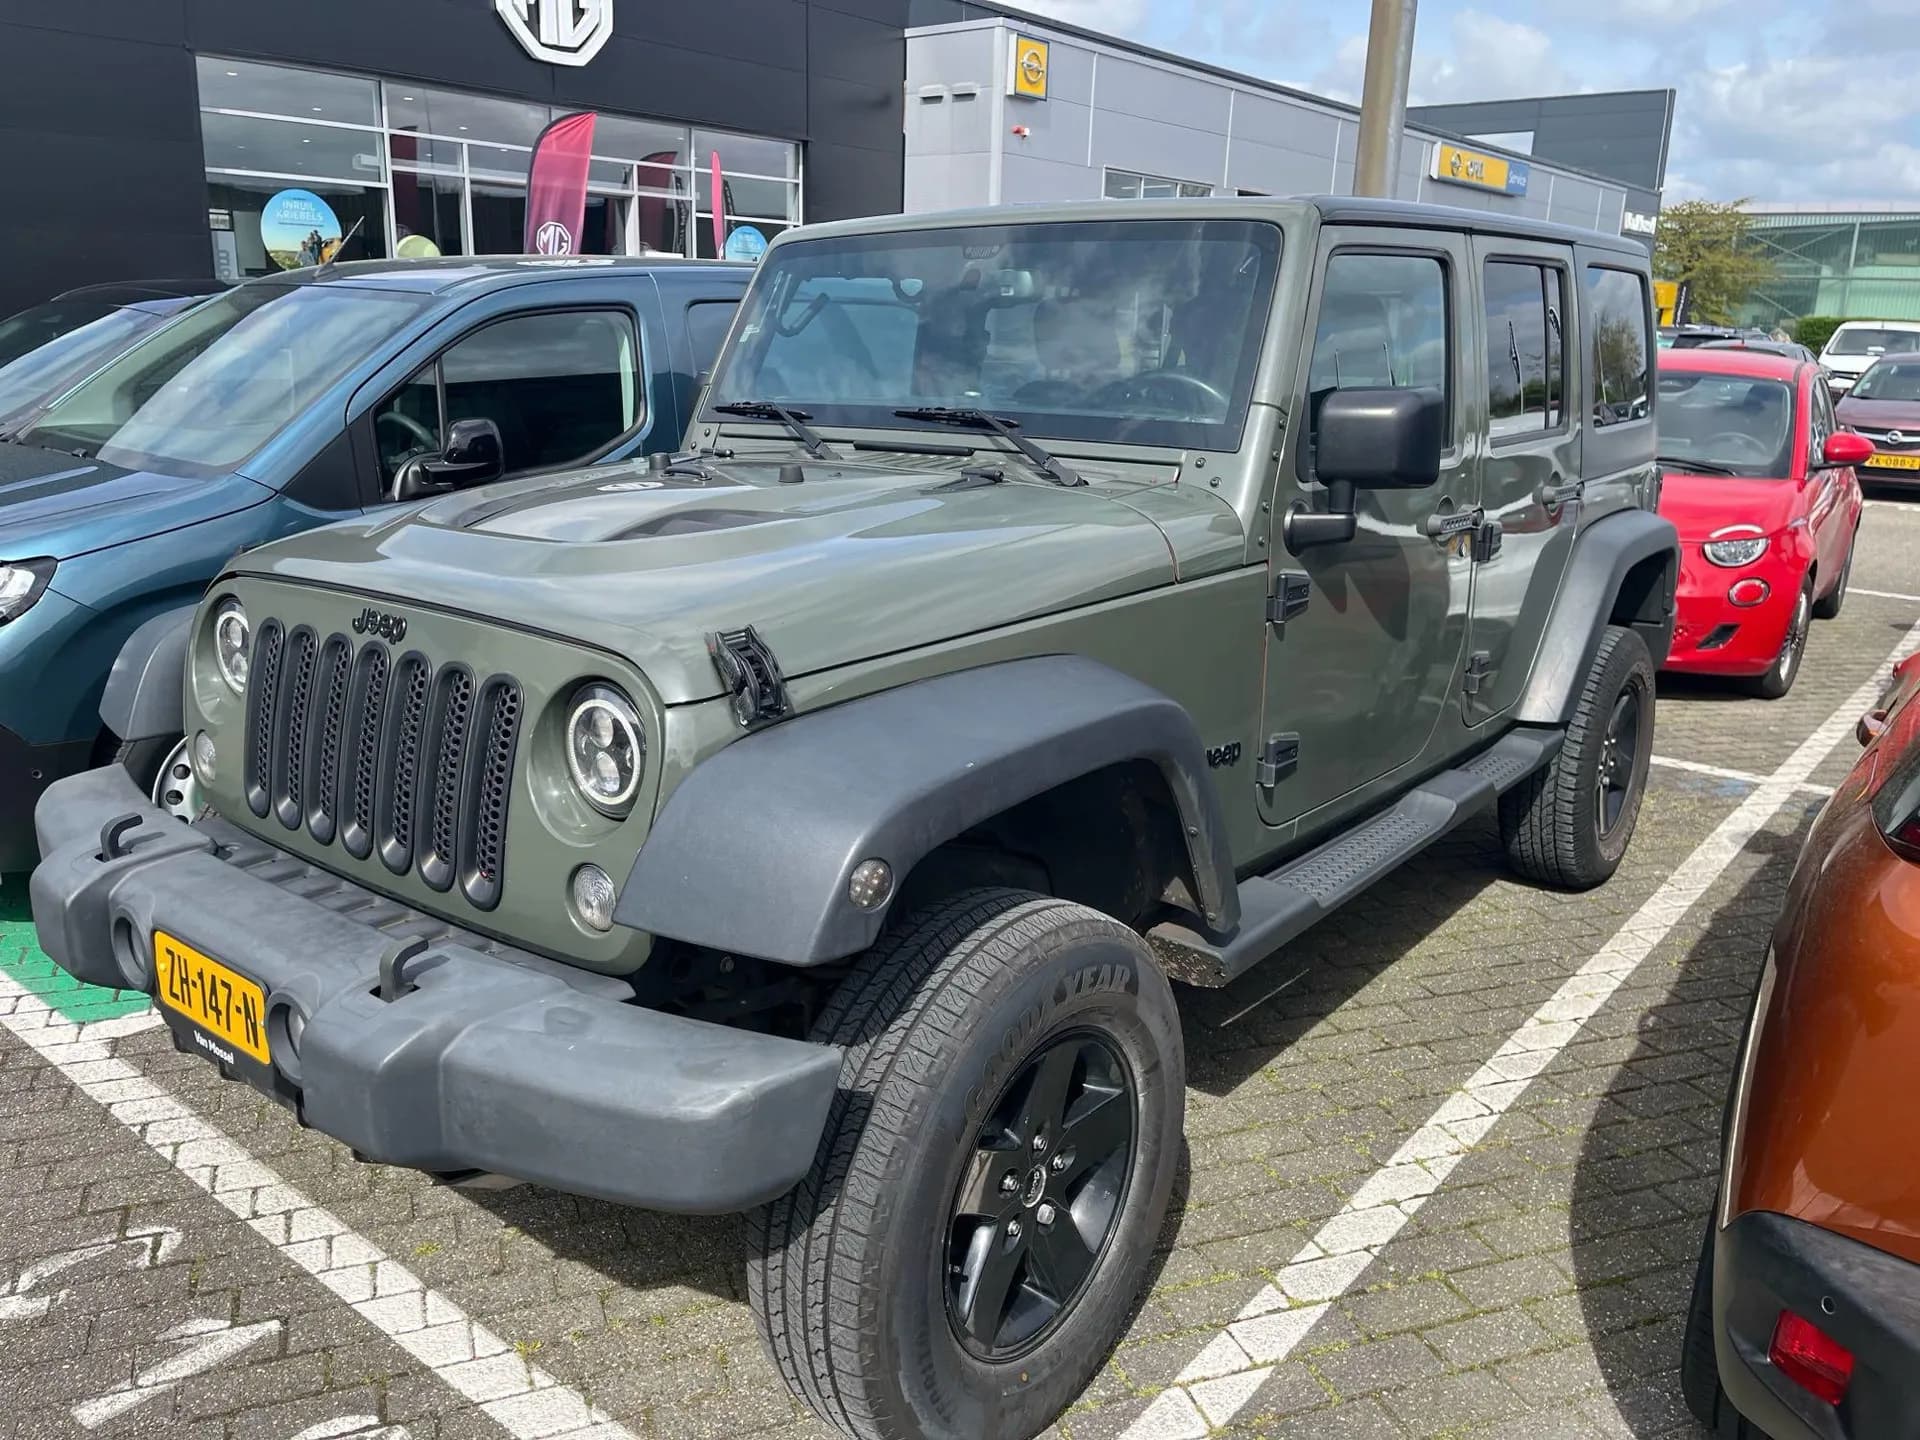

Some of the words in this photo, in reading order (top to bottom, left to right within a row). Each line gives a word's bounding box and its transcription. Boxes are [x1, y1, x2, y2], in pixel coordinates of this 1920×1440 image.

[539, 225, 570, 256] MG
[352, 607, 408, 645] Jeep
[165, 947, 259, 1049] ZH-147-N
[193, 1029, 209, 1049] Van
